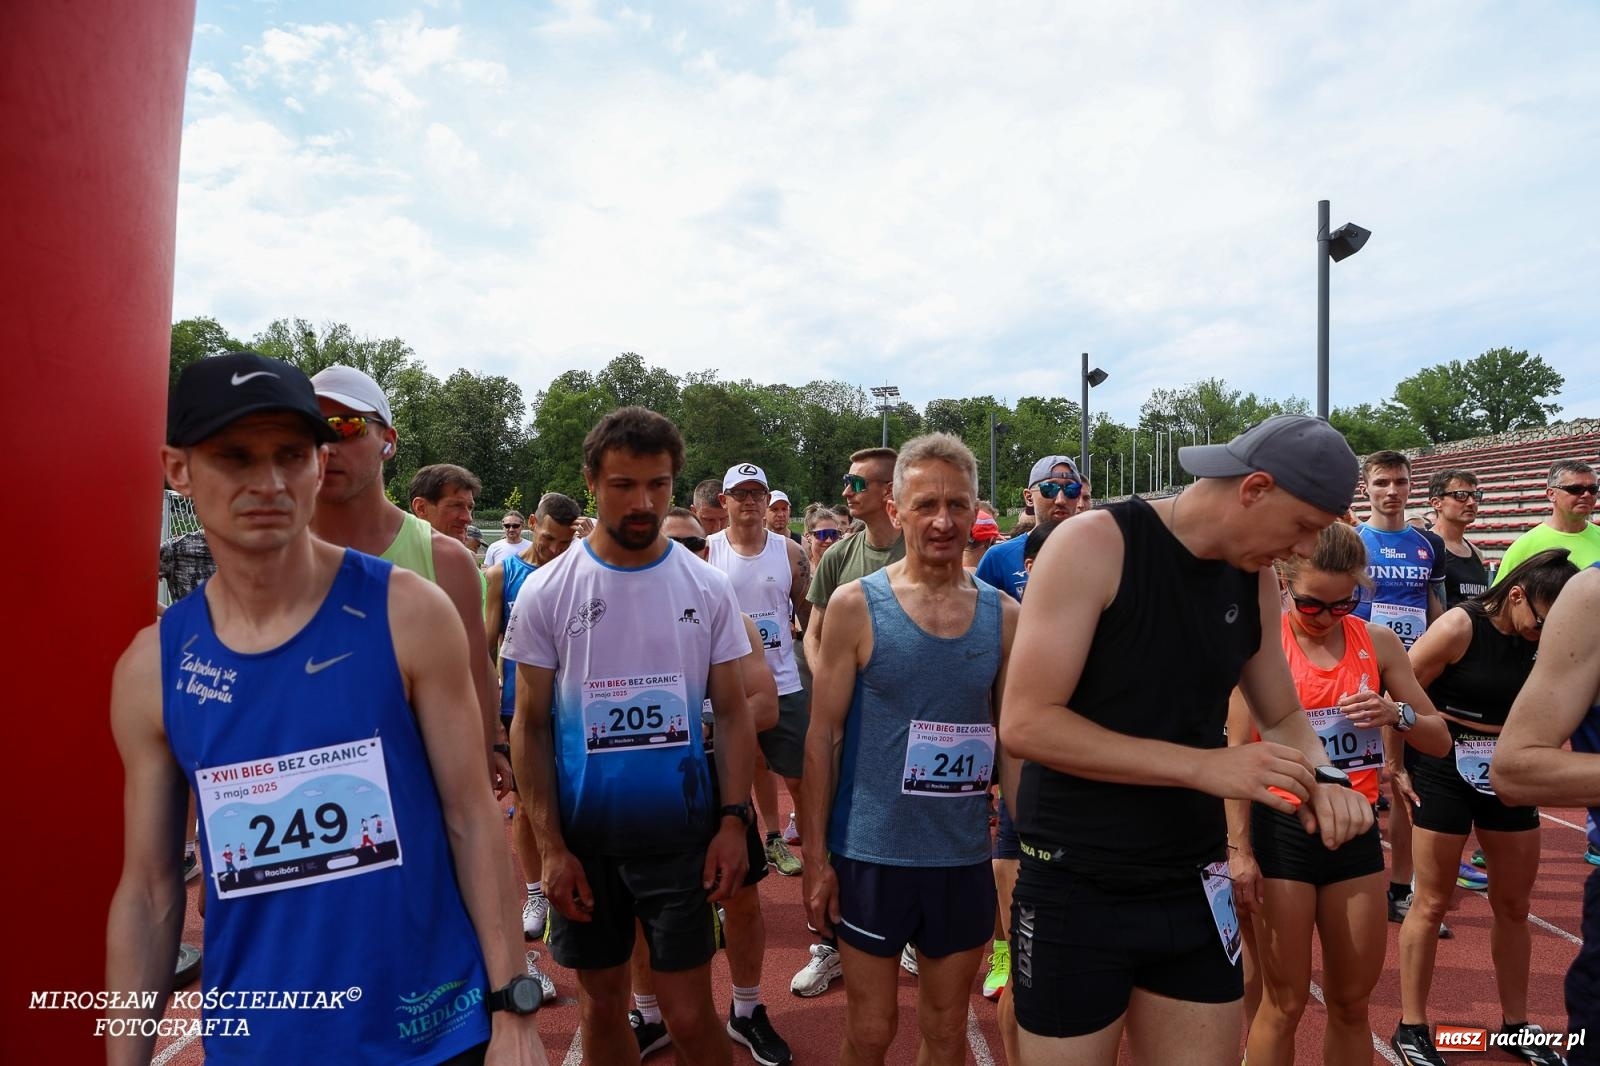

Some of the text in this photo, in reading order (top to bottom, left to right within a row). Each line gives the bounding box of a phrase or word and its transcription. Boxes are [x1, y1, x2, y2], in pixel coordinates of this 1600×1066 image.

[1365, 565, 1432, 580] UNNER
[759, 628, 768, 640] 9
[1386, 621, 1412, 635] 183
[186, 674, 232, 705] bieganiu
[589, 681, 605, 689] XVII
[607, 680, 627, 688] BIEG
[629, 678, 644, 686] BEZ
[646, 675, 678, 685] GRANIC
[609, 705, 664, 731] 205
[918, 723, 934, 731] XVII
[936, 724, 955, 733] BIEG
[211, 767, 238, 784] XVII
[241, 762, 274, 779] BIEG
[278, 756, 306, 773] BEZ
[309, 745, 368, 767] GRANIC
[932, 753, 975, 777] 241
[1478, 762, 1490, 780] 2
[214, 782, 278, 802] 3 maja 2025
[249, 802, 348, 857] 249
[1038, 850, 1051, 860] 10
[265, 866, 300, 877] Racibórz
[397, 987, 483, 1039] MEDLOR
